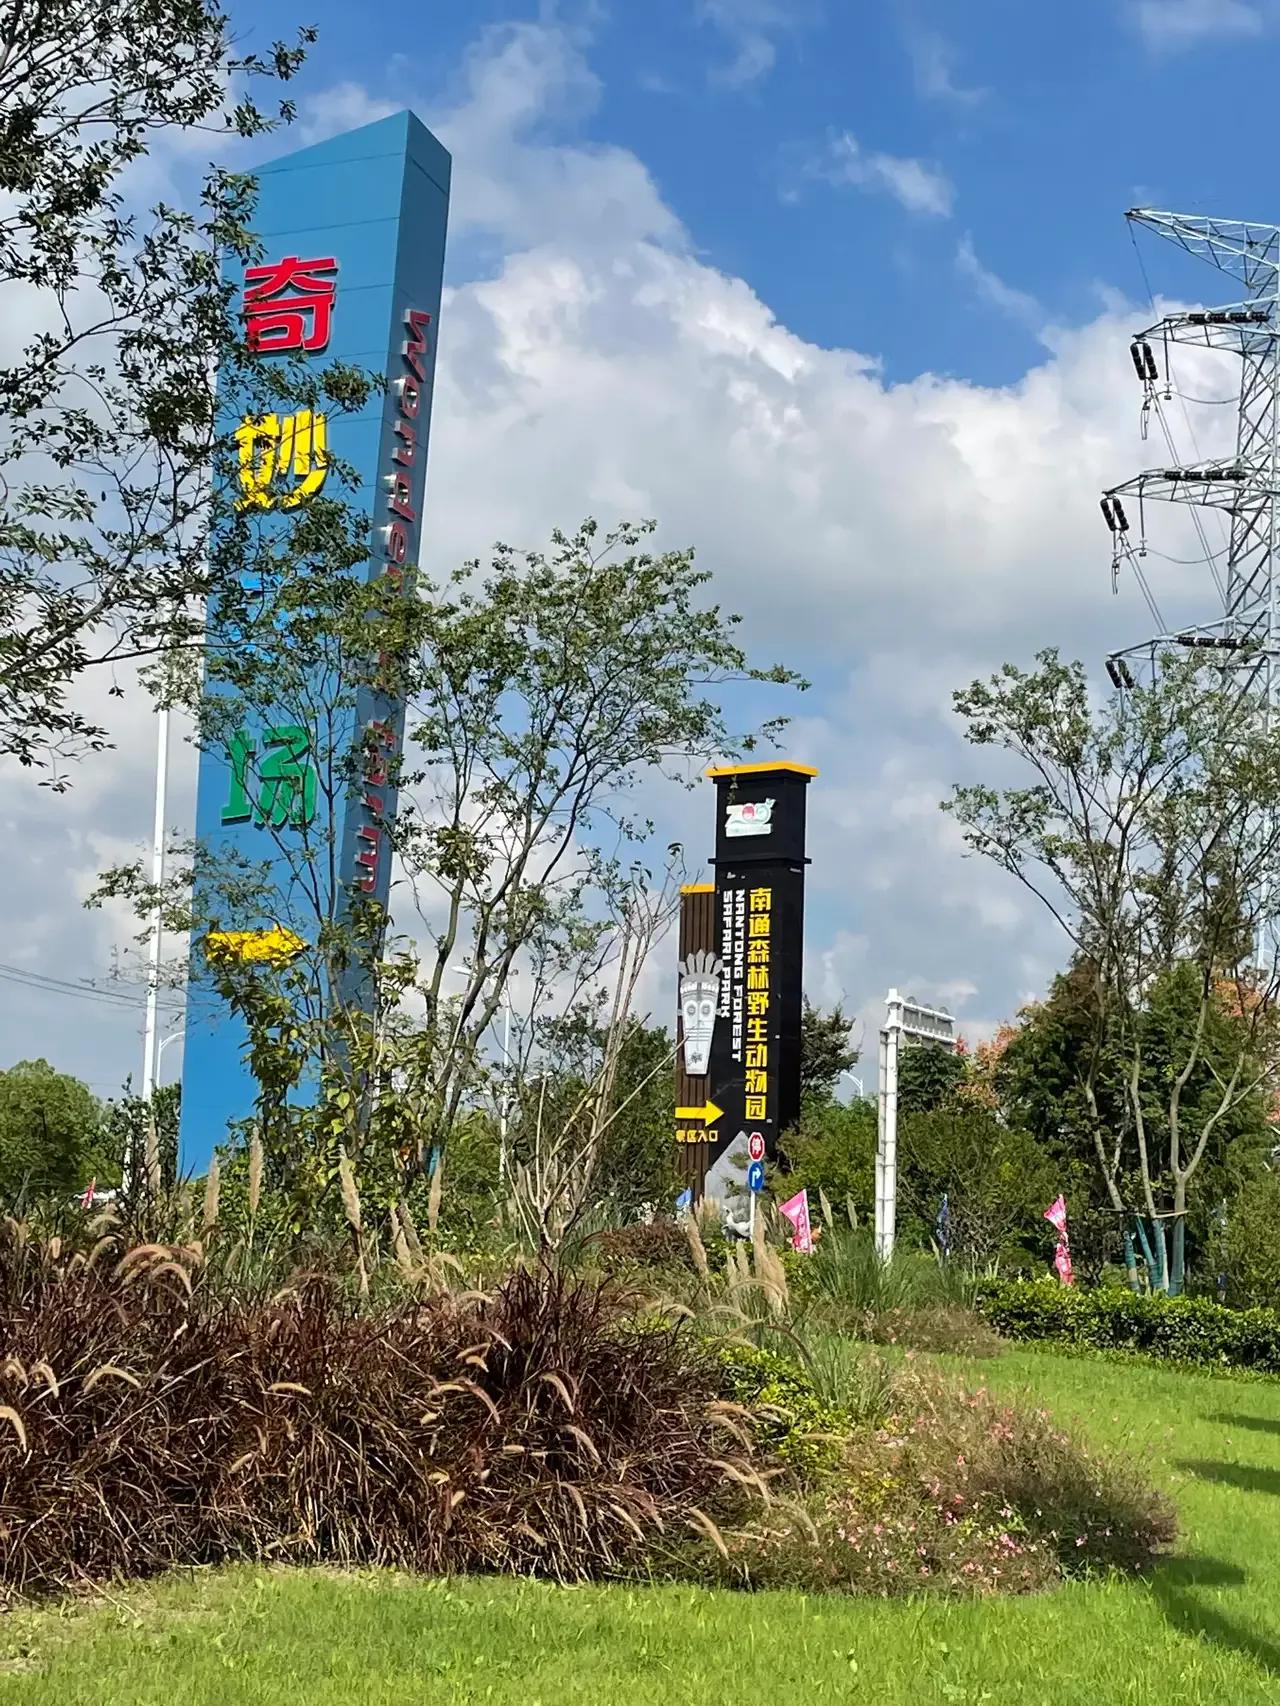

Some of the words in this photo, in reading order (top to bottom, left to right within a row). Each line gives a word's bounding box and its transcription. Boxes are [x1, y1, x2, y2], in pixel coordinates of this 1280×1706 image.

[221, 255, 338, 829] 奇妙场
[722, 889, 733, 961] SAFARI
[733, 889, 745, 979] NANTONG
[720, 966, 731, 1019] PARK
[732, 984, 743, 1062] FOREST
[744, 886, 772, 1120] 南通森林野生动物园
